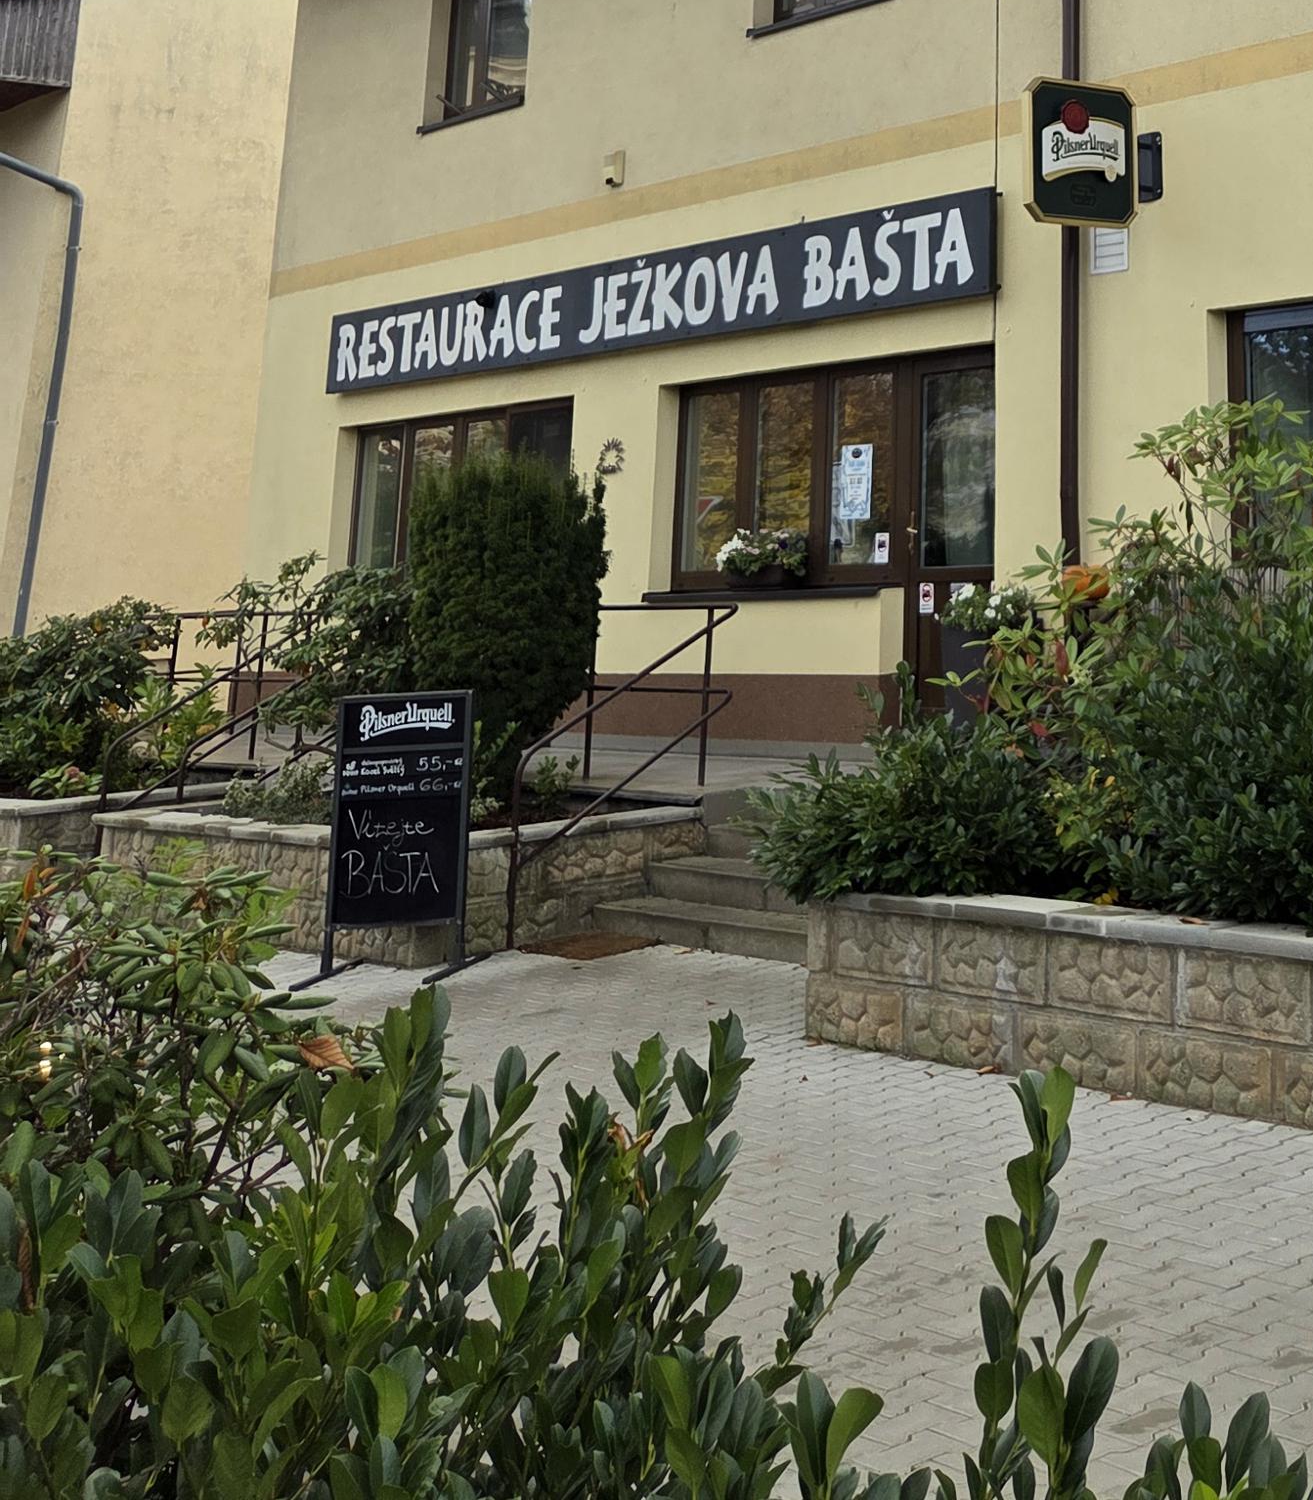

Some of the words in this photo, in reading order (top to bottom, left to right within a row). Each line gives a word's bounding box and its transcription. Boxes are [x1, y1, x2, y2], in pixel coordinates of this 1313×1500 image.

[1051, 130, 1090, 161] Pilsner
[1088, 132, 1118, 160] Urquell
[335, 284, 563, 382] RESTAURACE
[578, 243, 780, 346] JEŽKOVA
[801, 207, 975, 309] BAŠTA
[360, 705, 407, 741] Pilsner
[406, 702, 453, 731] Urquell
[340, 844, 440, 898] BAŠTA
